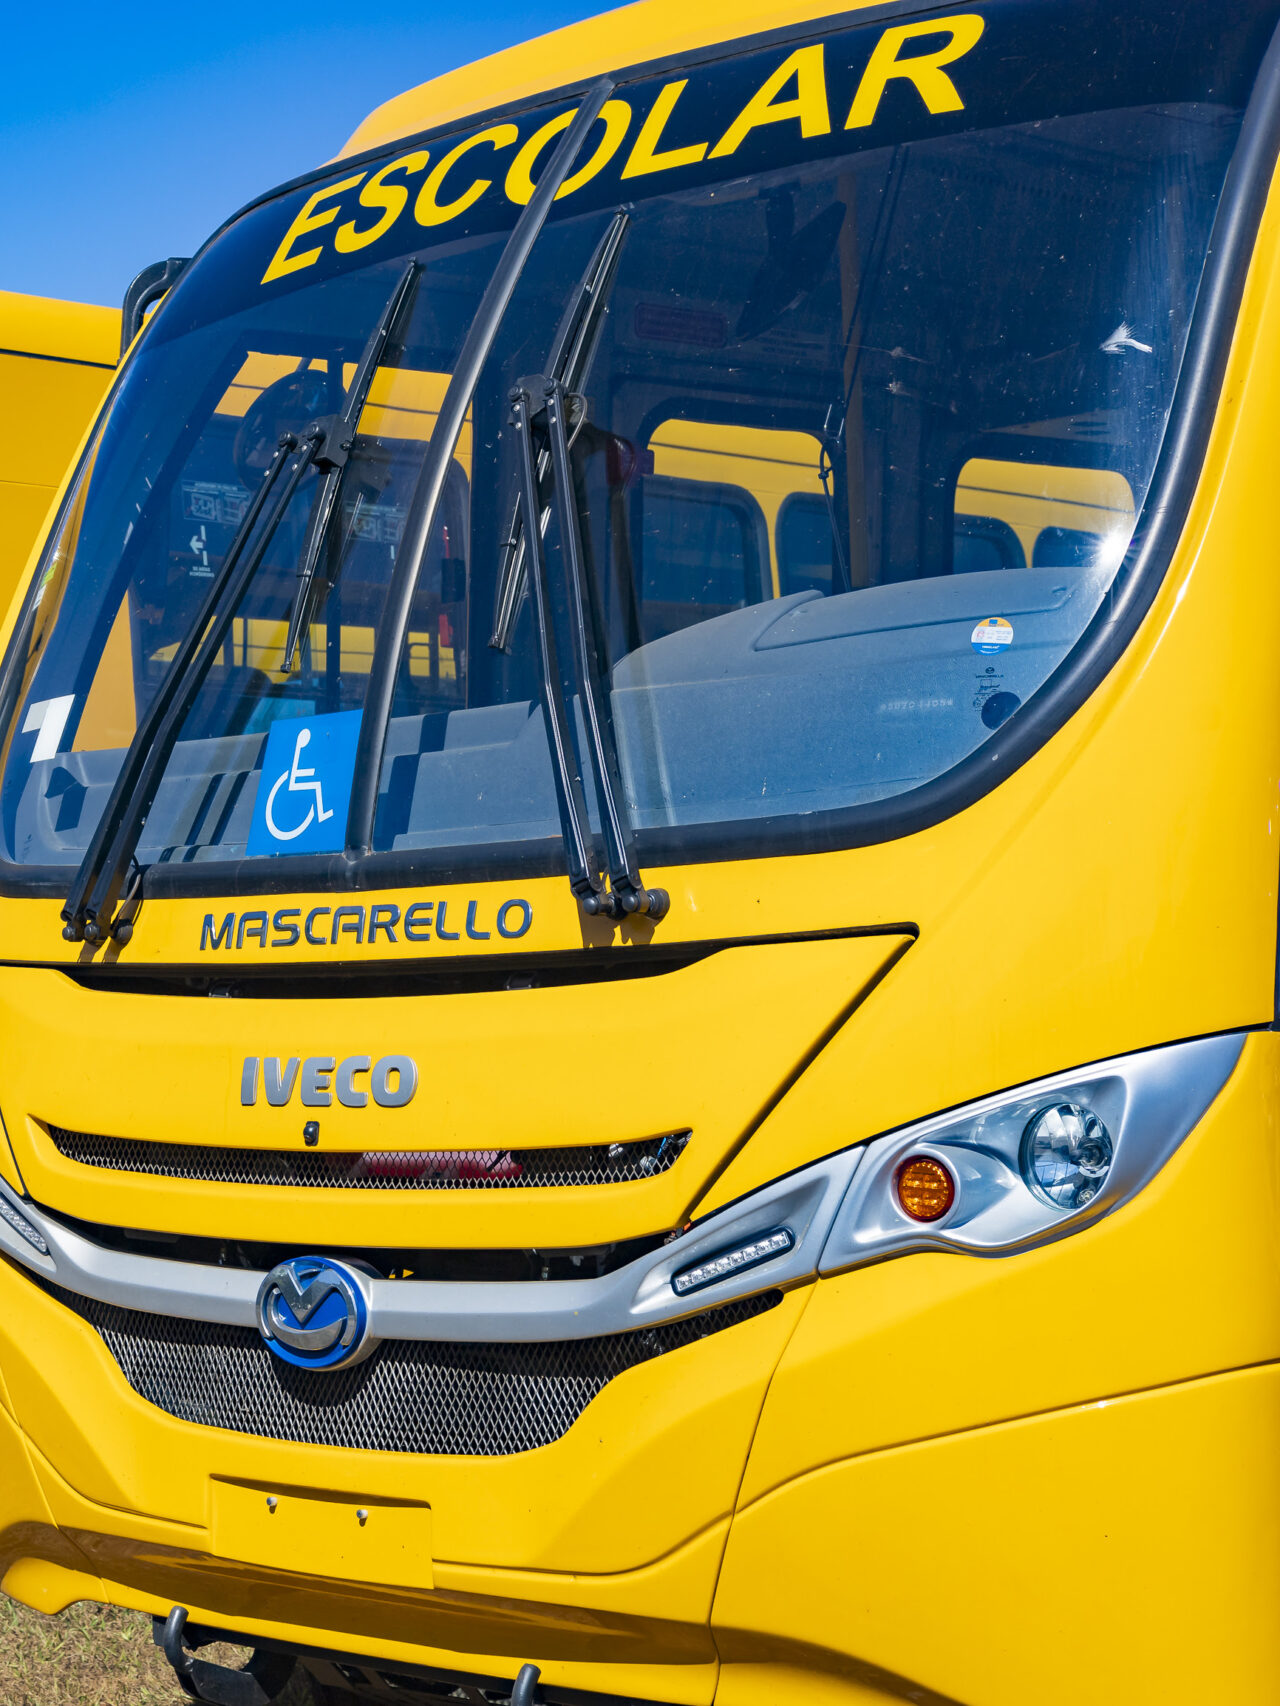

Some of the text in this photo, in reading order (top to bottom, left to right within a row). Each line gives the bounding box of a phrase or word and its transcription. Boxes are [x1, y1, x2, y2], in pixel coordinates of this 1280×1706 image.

[261, 14, 985, 284] ESCOLAR
[200, 899, 533, 950] MASCARELLO
[241, 1055, 419, 1107] IVECO
